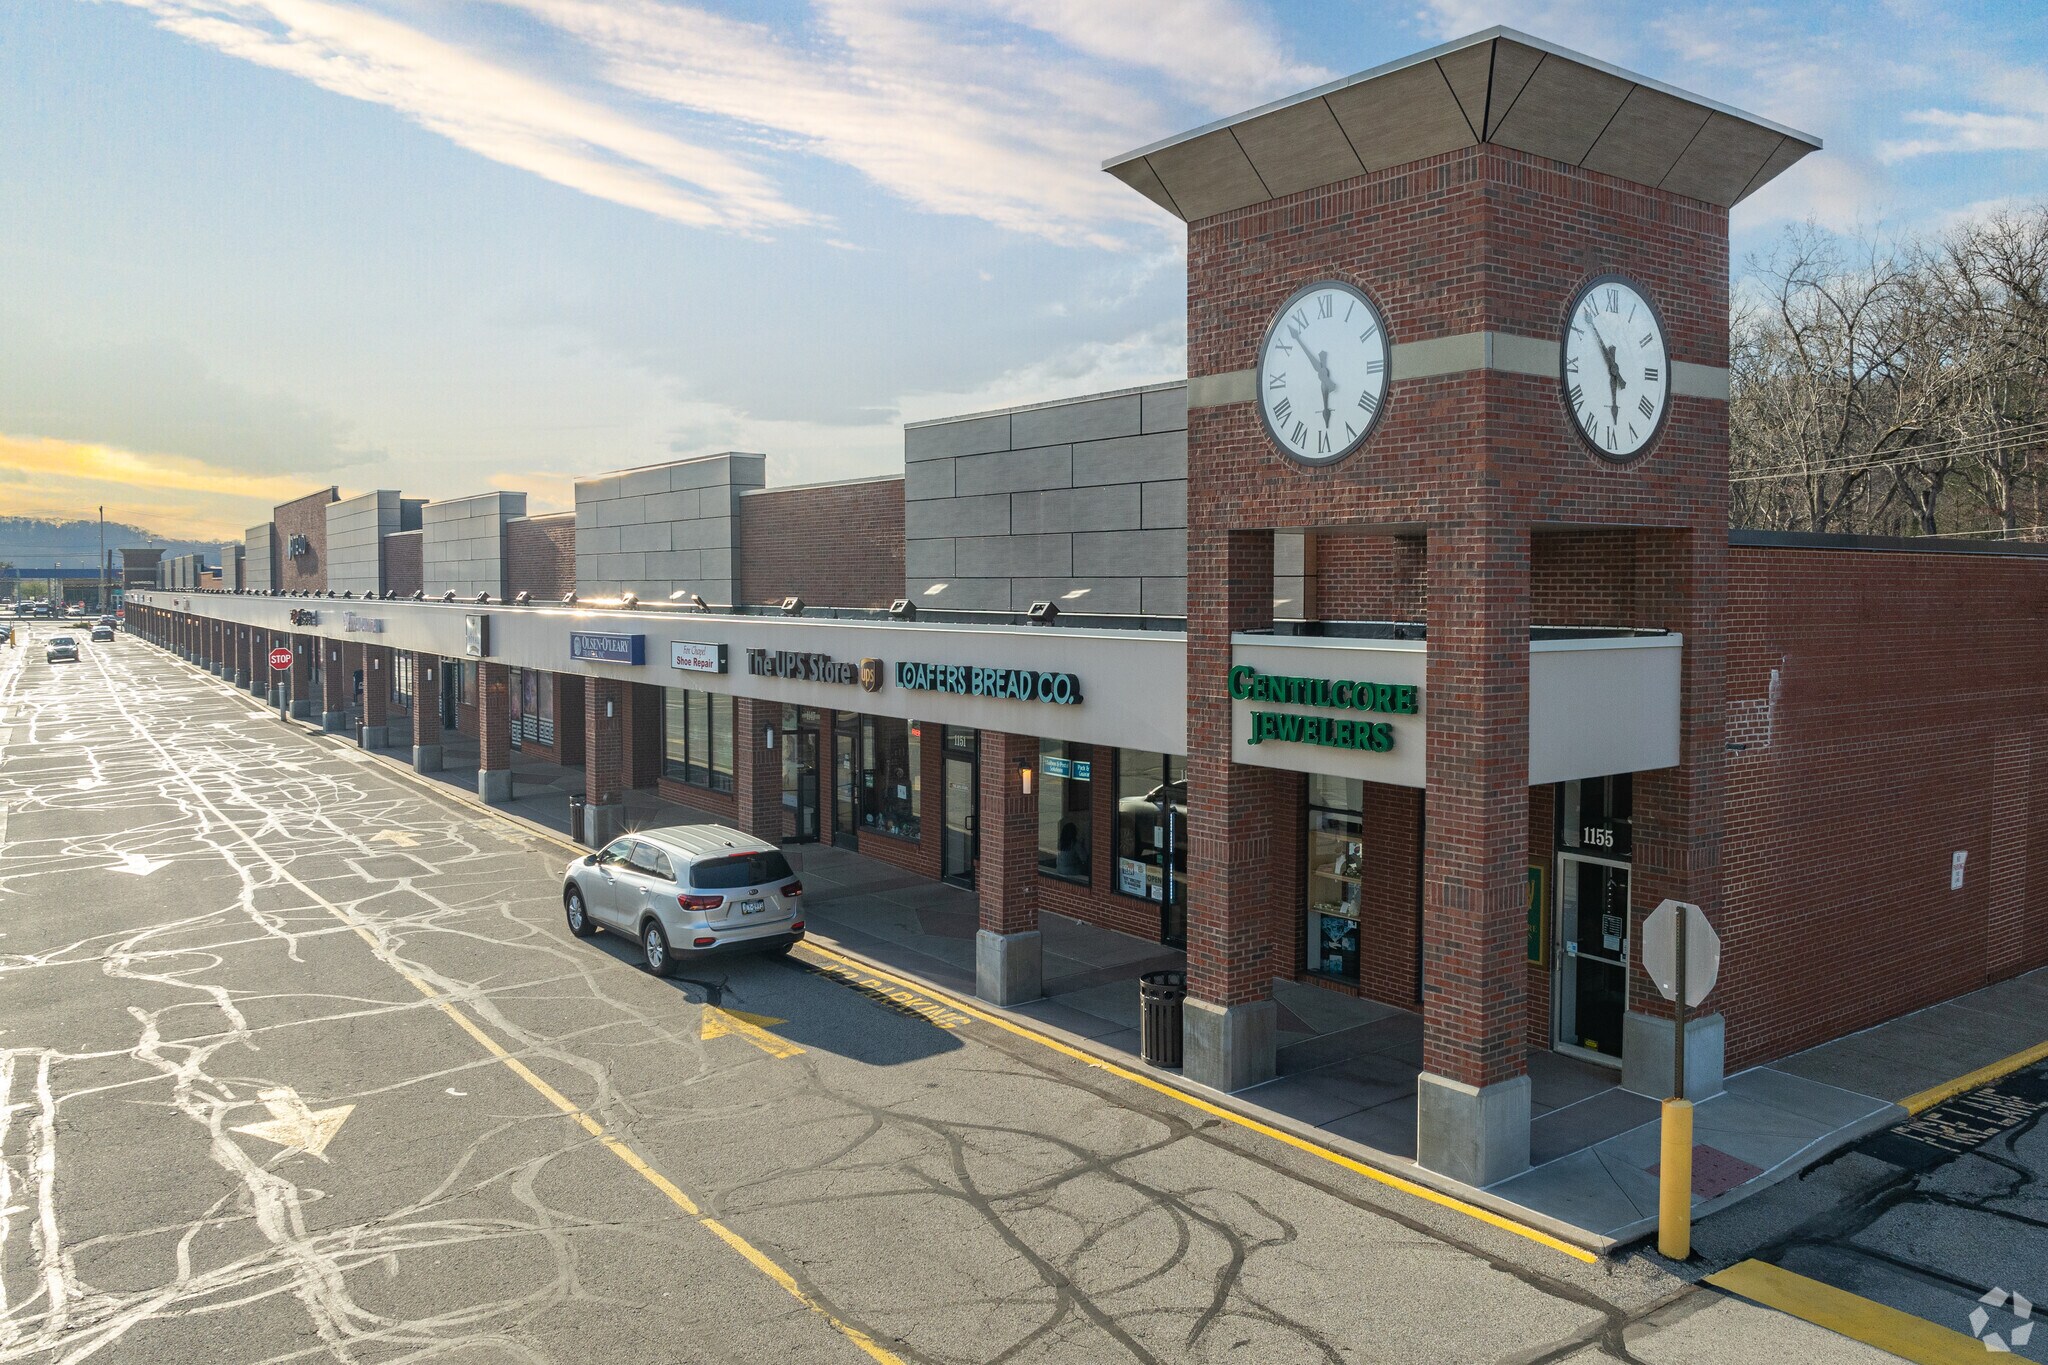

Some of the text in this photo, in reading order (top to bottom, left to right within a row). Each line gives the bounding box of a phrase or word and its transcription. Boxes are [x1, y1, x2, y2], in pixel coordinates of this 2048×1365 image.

[270, 654, 292, 665] STOP
[676, 656, 692, 666] Shoe
[693, 657, 714, 669] Repair
[746, 648, 853, 685] The UPS Store
[861, 668, 876, 687] ups
[895, 661, 1078, 706] LOAFERS BREAD CO.
[1228, 665, 1418, 715] GENTILCORE
[954, 734, 967, 748] 1151
[1247, 710, 1395, 753] JEWELERS
[1583, 827, 1614, 848] 1155
[1147, 874, 1162, 885] OPEN
[1890, 1112, 2000, 1153] FIRE
